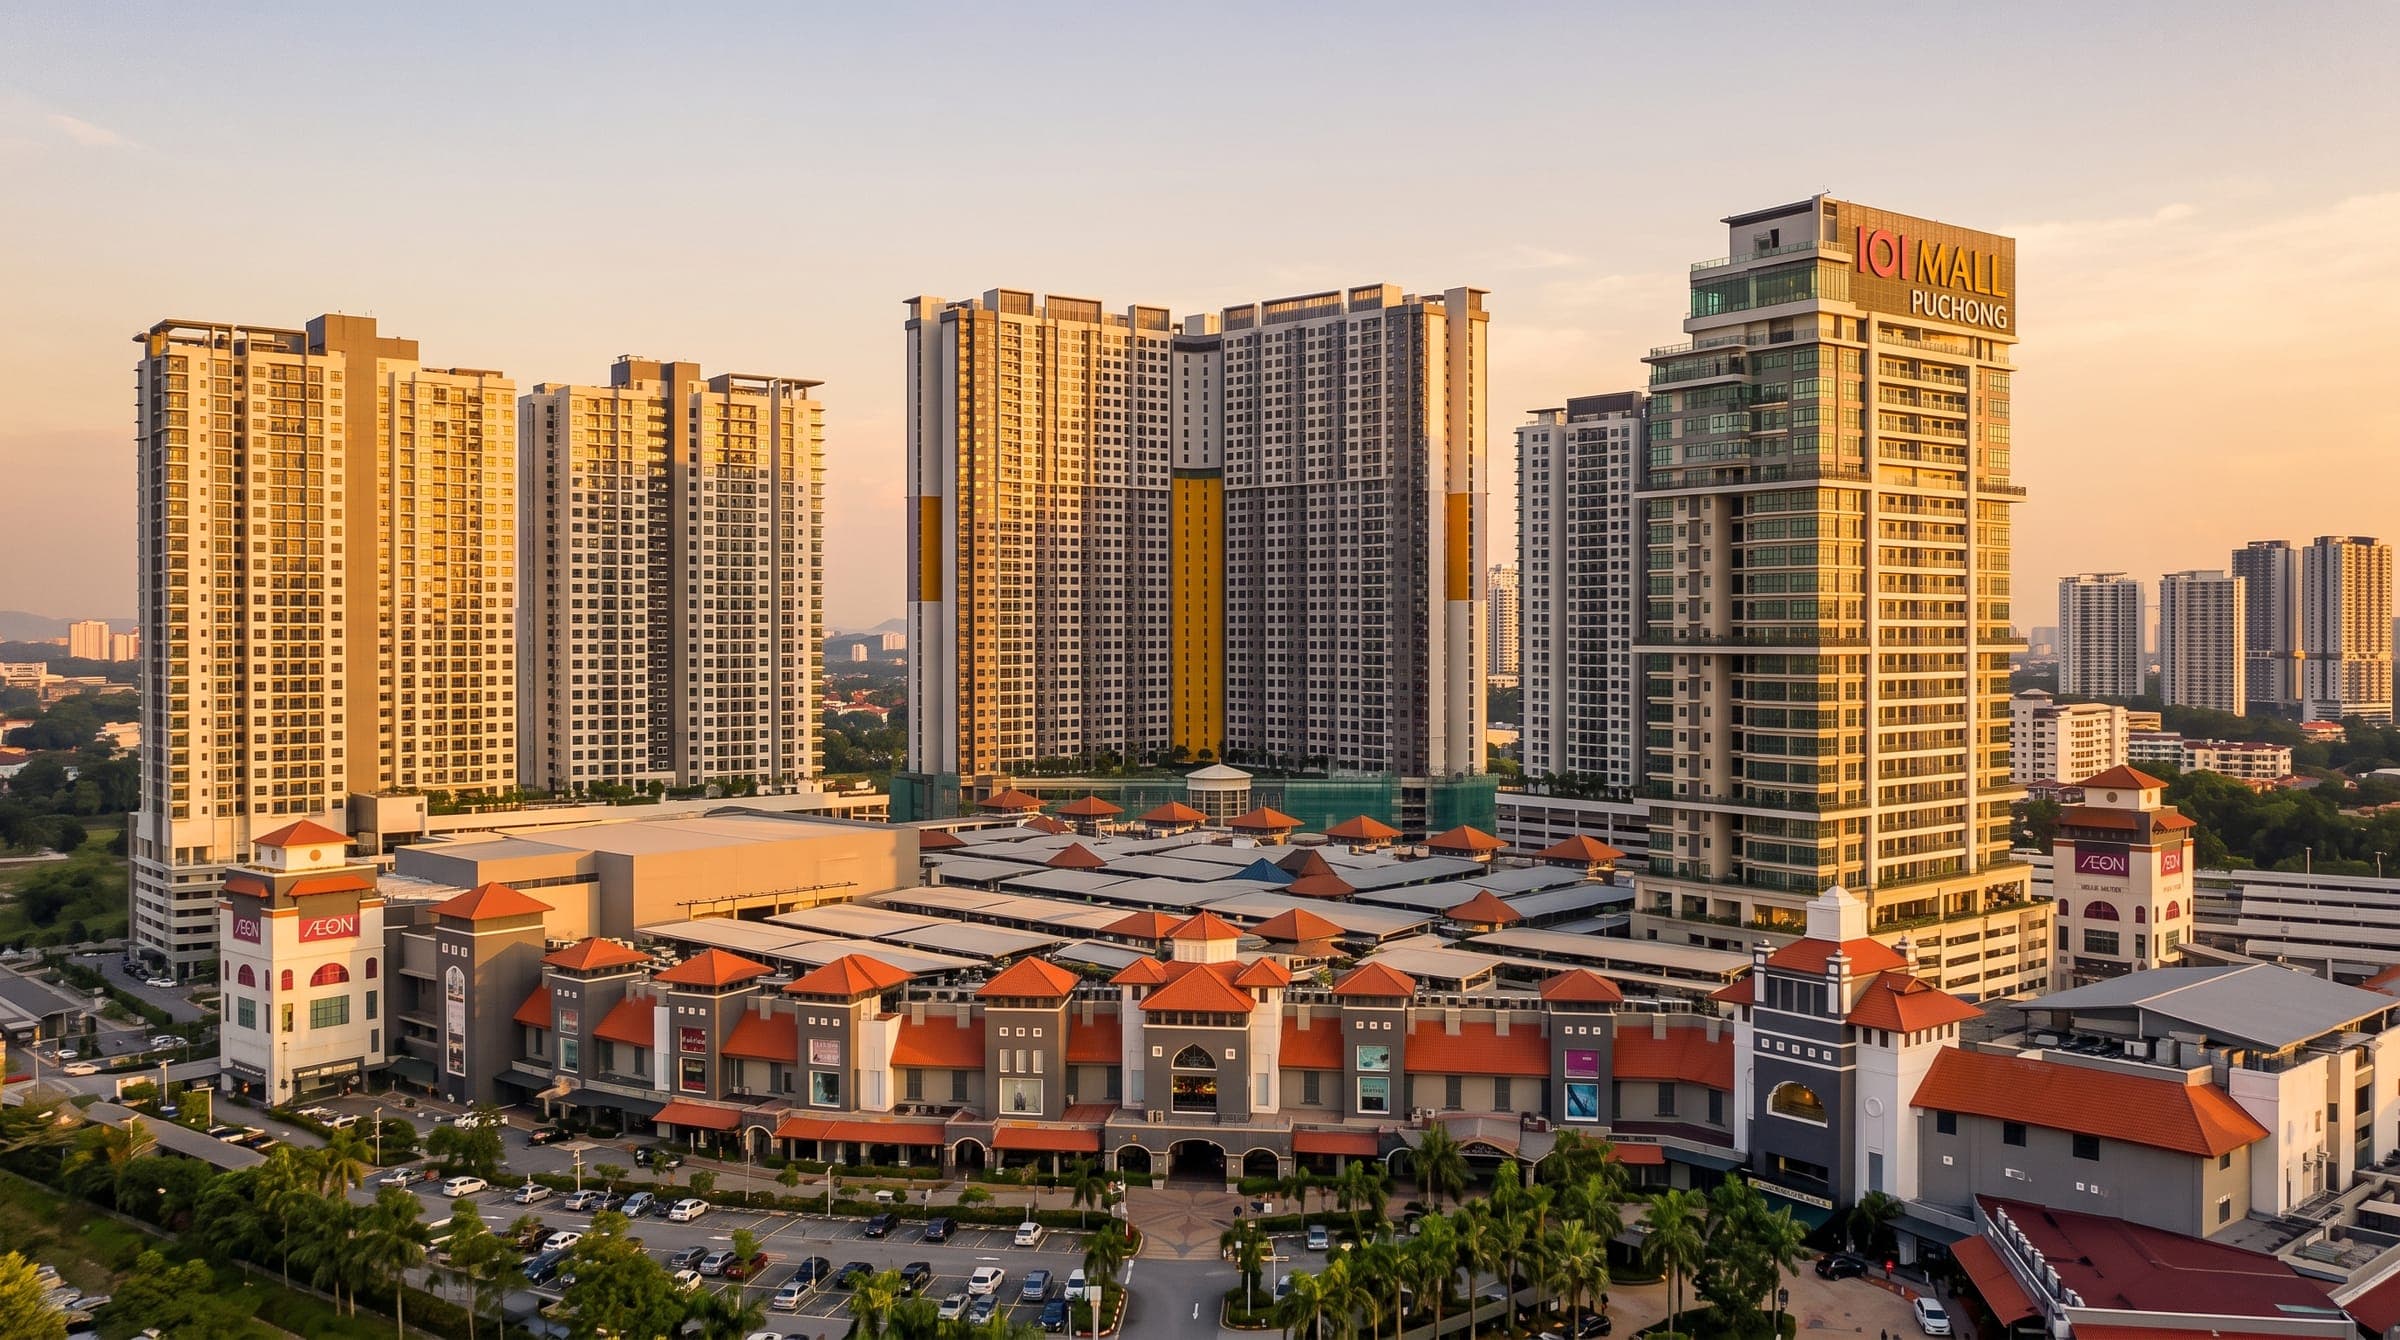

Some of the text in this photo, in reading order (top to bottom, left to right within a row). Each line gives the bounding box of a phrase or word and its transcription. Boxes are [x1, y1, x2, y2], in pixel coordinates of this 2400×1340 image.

[1857, 225, 2008, 298] IOI MALL
[1911, 289, 2008, 329] PUCHONG
